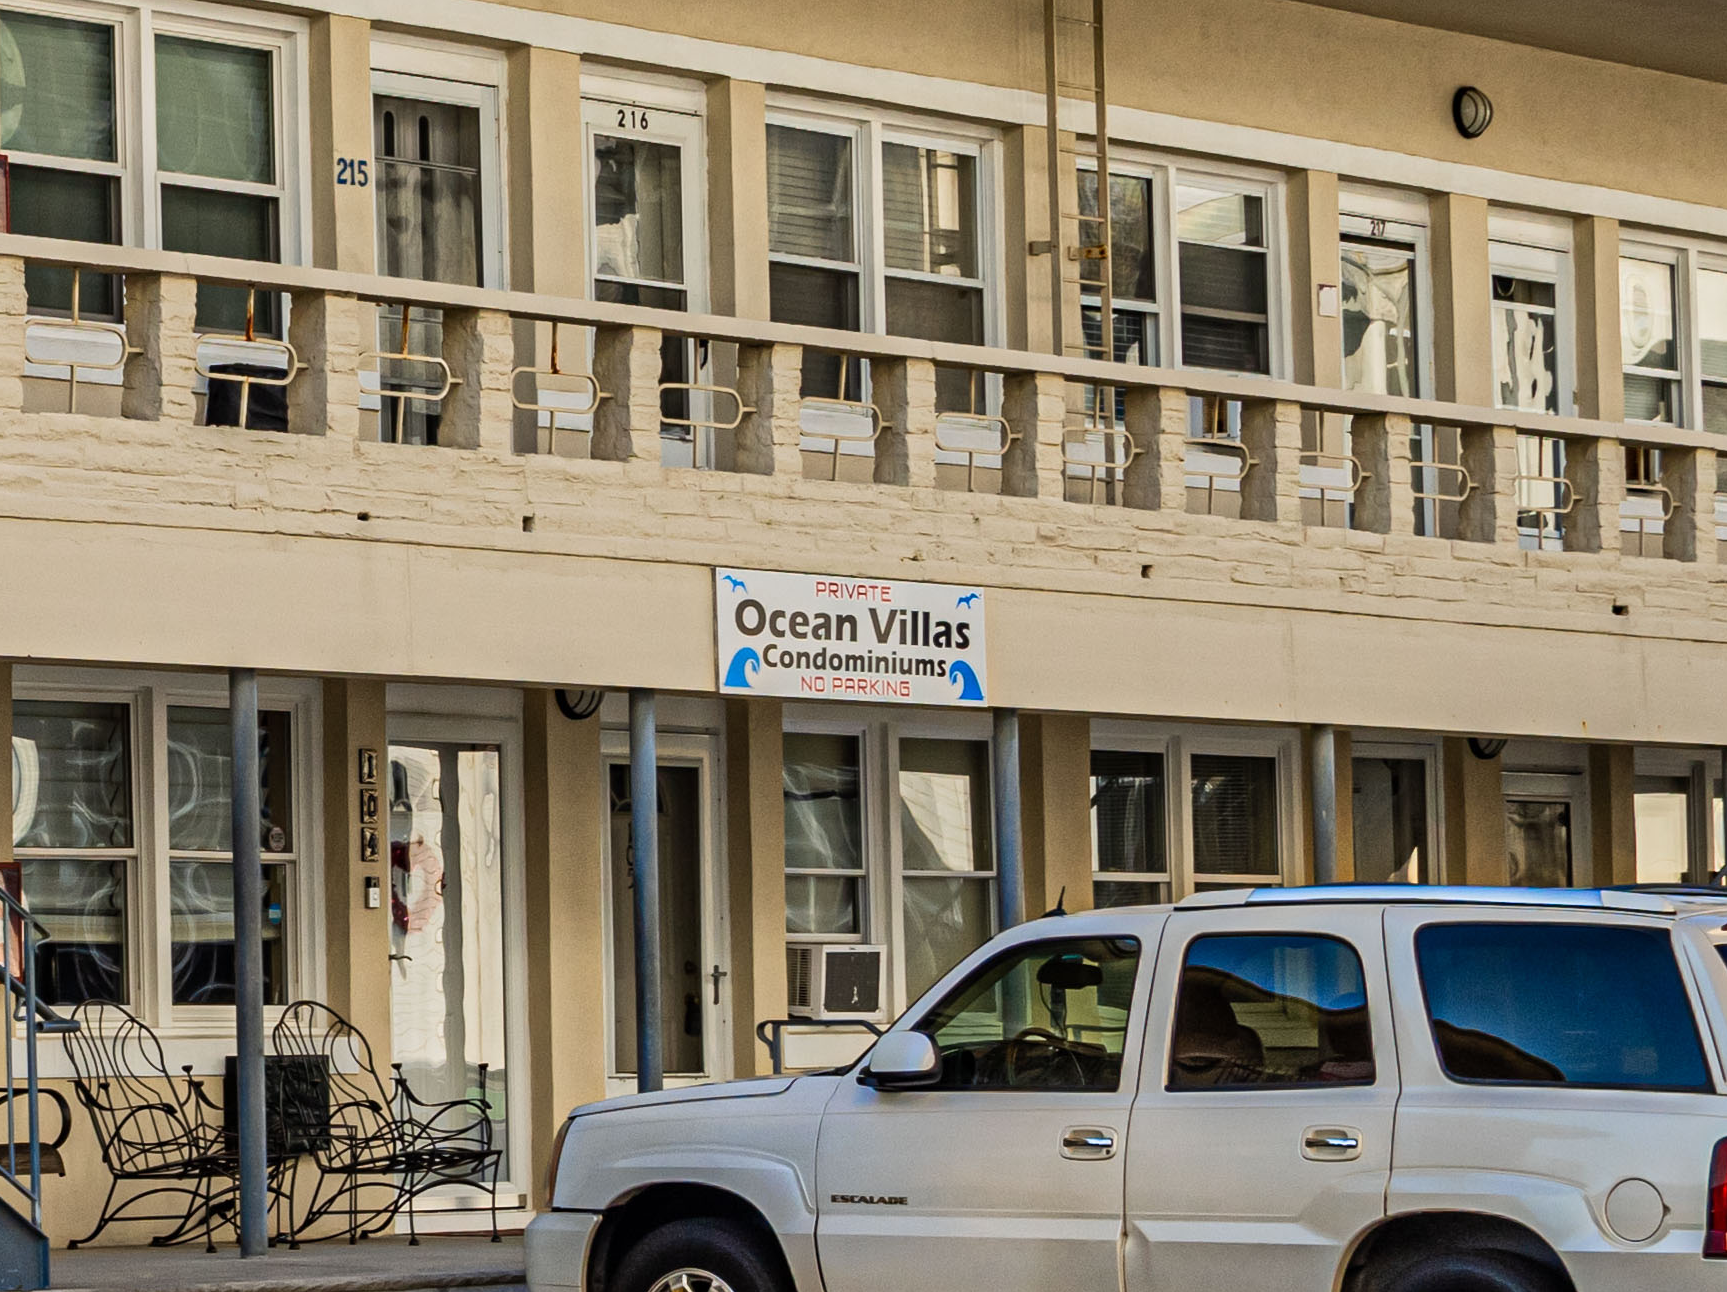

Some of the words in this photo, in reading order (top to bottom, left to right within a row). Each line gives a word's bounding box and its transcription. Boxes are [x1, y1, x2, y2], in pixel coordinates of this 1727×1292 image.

[617, 109, 648, 130] 216
[337, 157, 368, 187] 215
[1371, 220, 1386, 237] 217
[815, 581, 892, 603] PRIVATE
[735, 598, 858, 643] Ocean
[868, 607, 970, 649] Villas
[762, 644, 947, 677] Condominiums
[801, 676, 825, 693] NO
[832, 677, 910, 698] PARKING
[831, 1194, 908, 1205] ESCALADE
